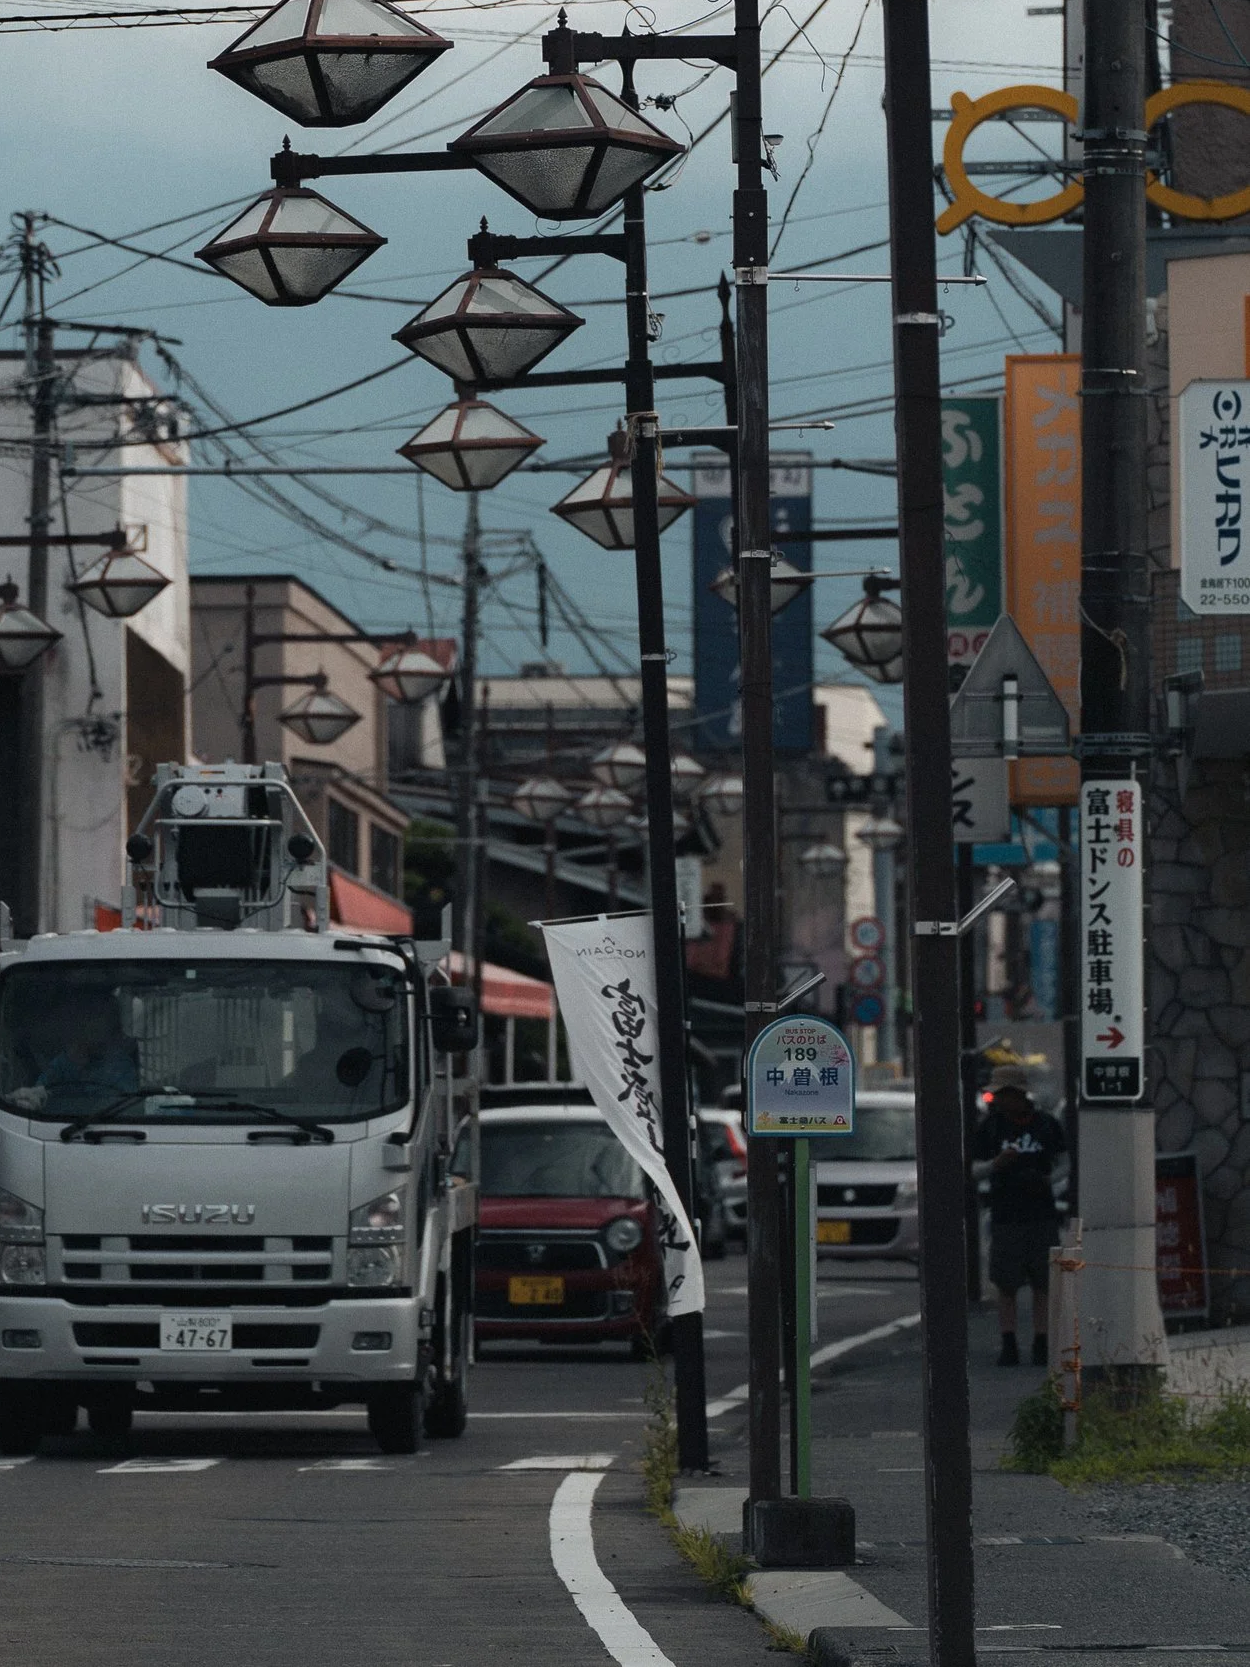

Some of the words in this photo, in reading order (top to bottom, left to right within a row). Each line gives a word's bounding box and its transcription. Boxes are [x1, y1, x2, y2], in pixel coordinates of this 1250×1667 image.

[1116, 790, 1135, 868] 寝具の
[1086, 788, 1114, 1015] 富士ドンス駐車場
[776, 1035, 827, 1045] バスのりば
[784, 1047, 817, 1061] 189
[766, 1067, 838, 1086] 中曽根
[141, 1204, 255, 1225] ISUZU
[176, 1329, 228, 1347] 47-67
